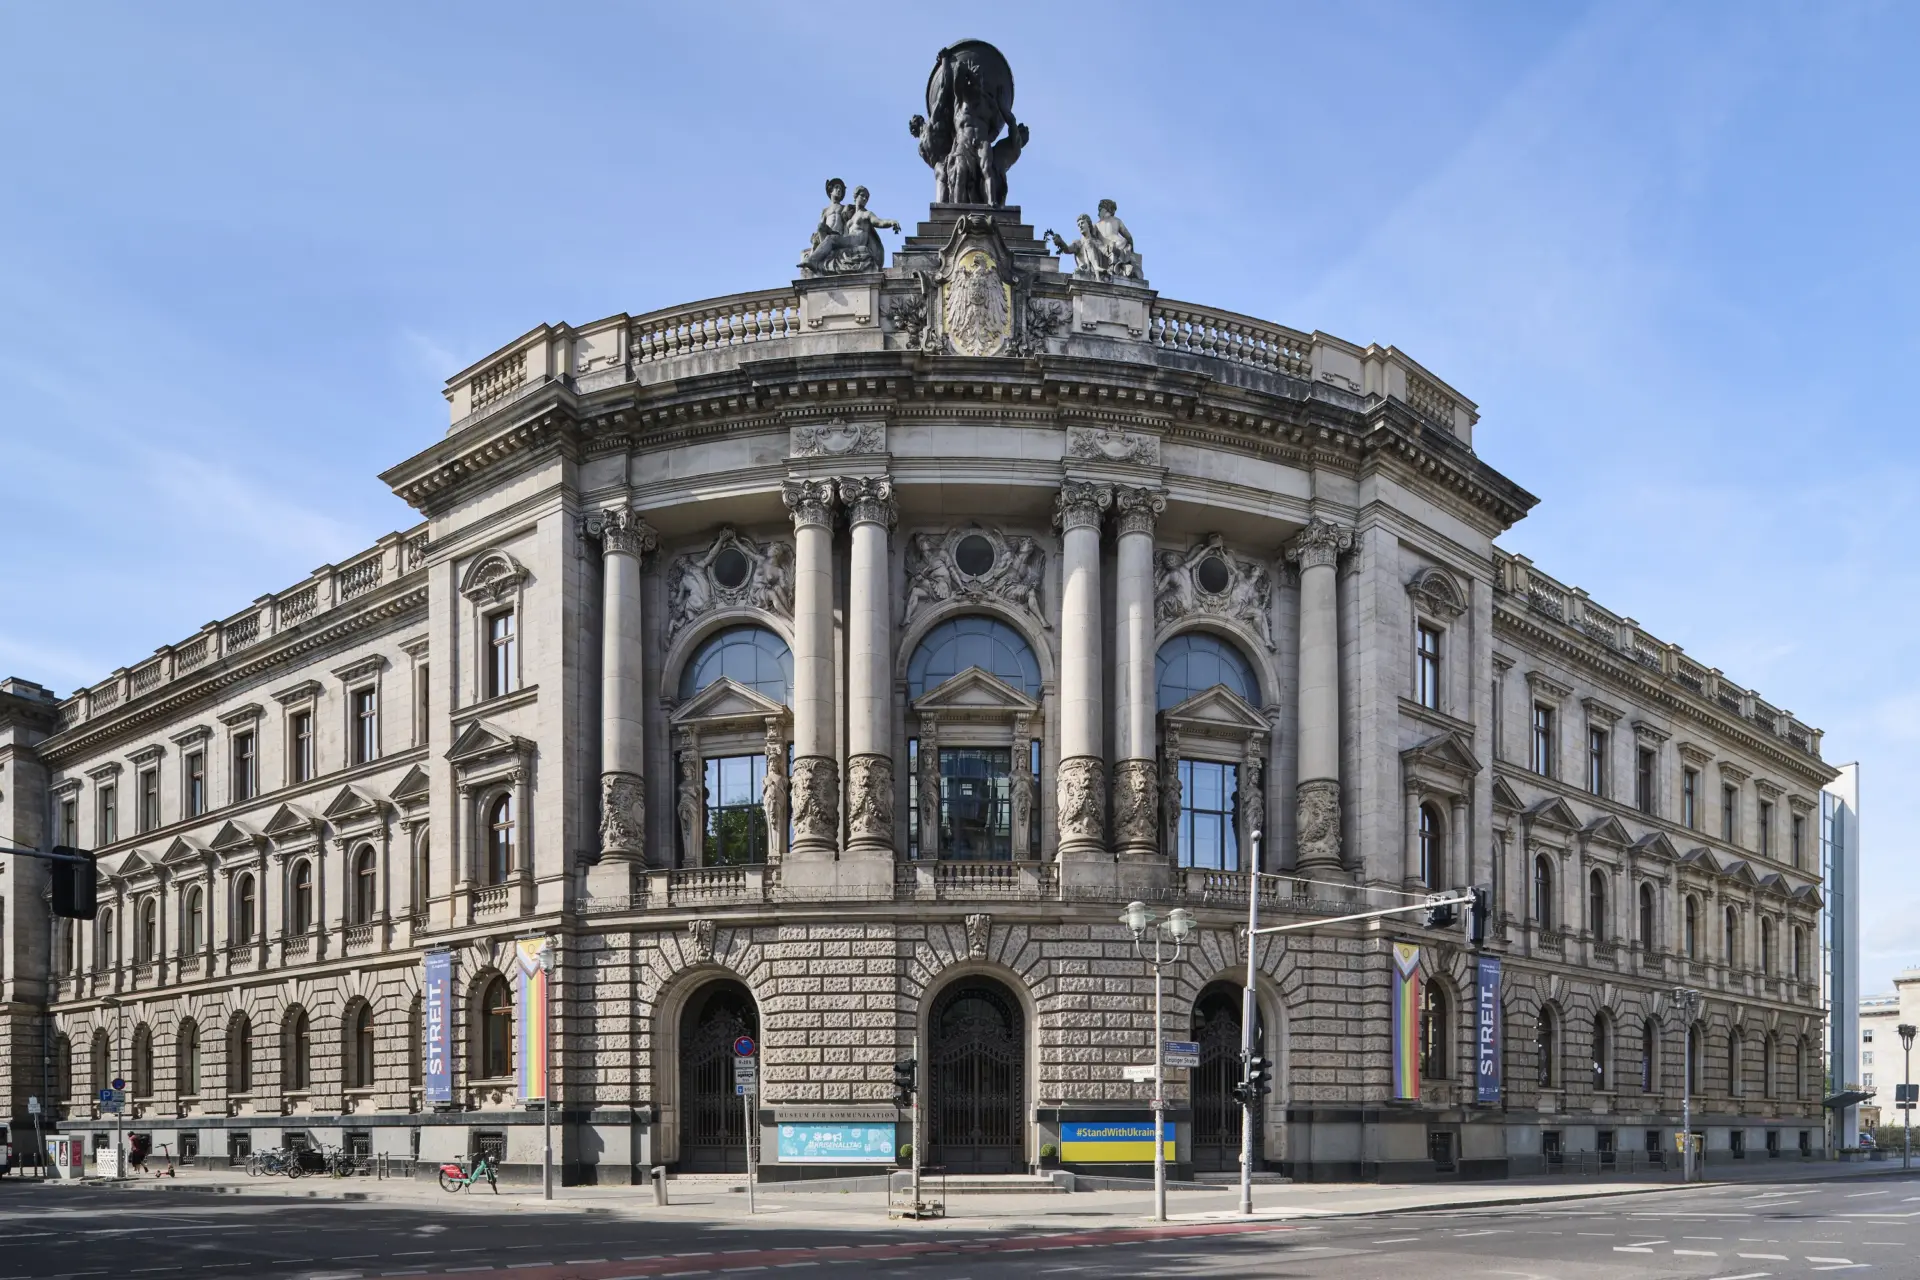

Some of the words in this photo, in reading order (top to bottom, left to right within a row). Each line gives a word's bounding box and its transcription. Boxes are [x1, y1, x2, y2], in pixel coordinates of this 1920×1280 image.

[429, 979, 442, 1075] STREIT.
[1481, 983, 1493, 1075] STREIT.
[103, 1090, 110, 1100] P
[1076, 1128, 1156, 1136] #StandWithUkrain
